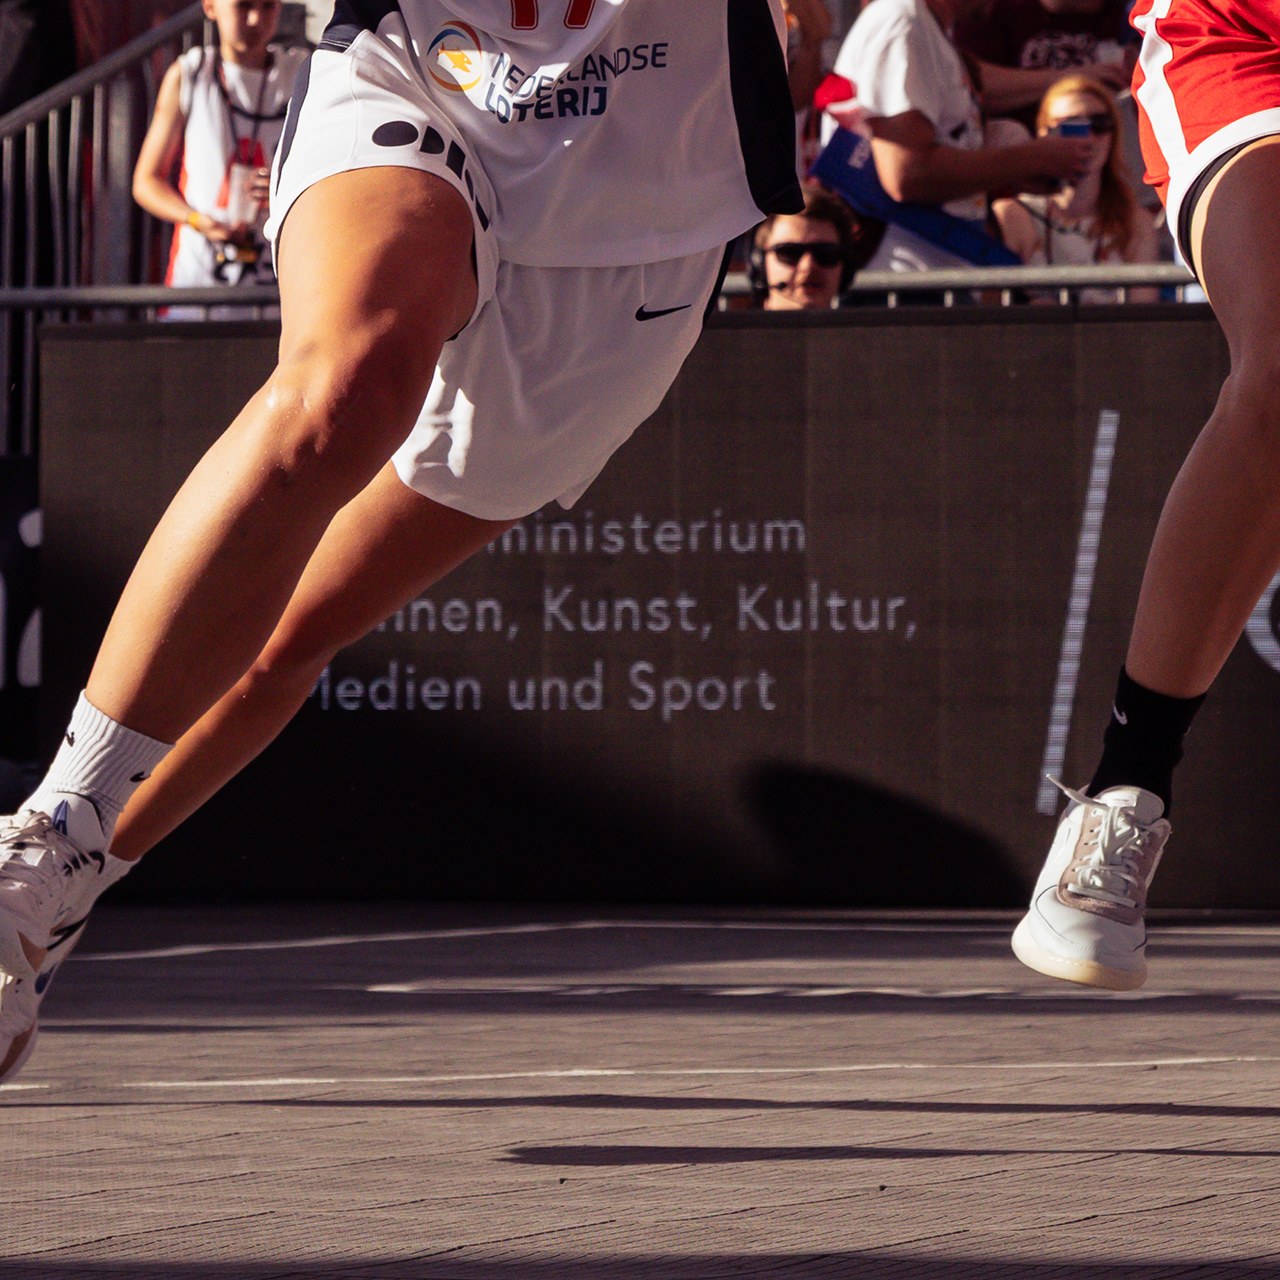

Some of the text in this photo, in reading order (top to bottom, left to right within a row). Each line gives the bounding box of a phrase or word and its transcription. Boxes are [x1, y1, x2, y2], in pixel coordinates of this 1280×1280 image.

[491, 43, 669, 99] NEDELANDSE
[485, 82, 607, 125] LOTERIJ
[485, 510, 807, 554] ministerium
[543, 584, 713, 642] Kunst,
[737, 581, 917, 642] Kultur,
[508, 660, 604, 712] und
[628, 660, 777, 723] Sport
